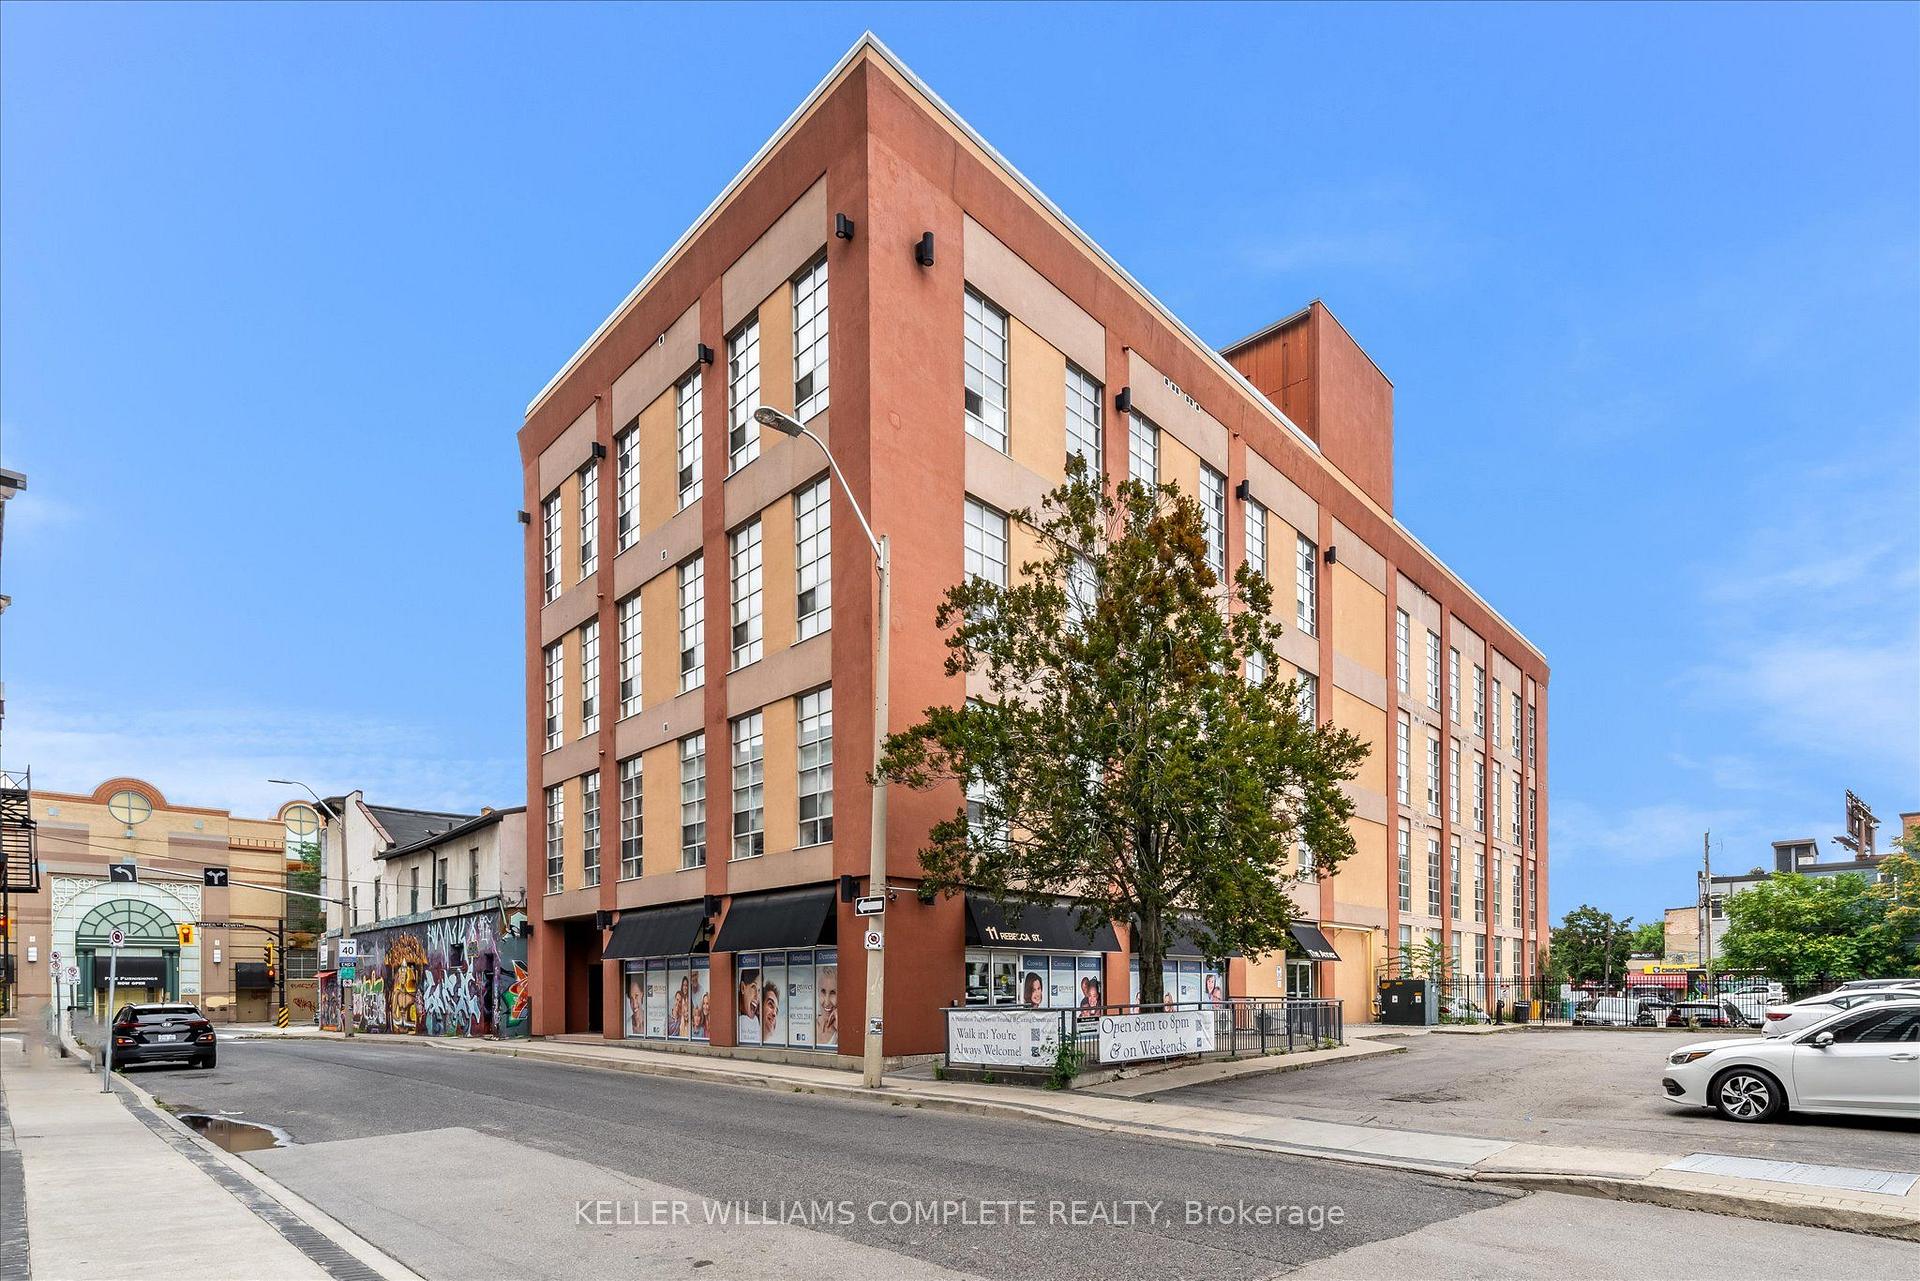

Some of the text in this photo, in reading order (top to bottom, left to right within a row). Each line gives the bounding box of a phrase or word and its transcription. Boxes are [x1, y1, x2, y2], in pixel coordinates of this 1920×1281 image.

[985, 926, 999, 940] 11
[342, 946, 354, 955] 40
[1101, 1014, 1190, 1038] Open 8am to 8pm
[956, 1027, 1017, 1041] Walk in! You're
[954, 1043, 1022, 1057] Always Welcome!
[1109, 1036, 1188, 1059] & on Weekends
